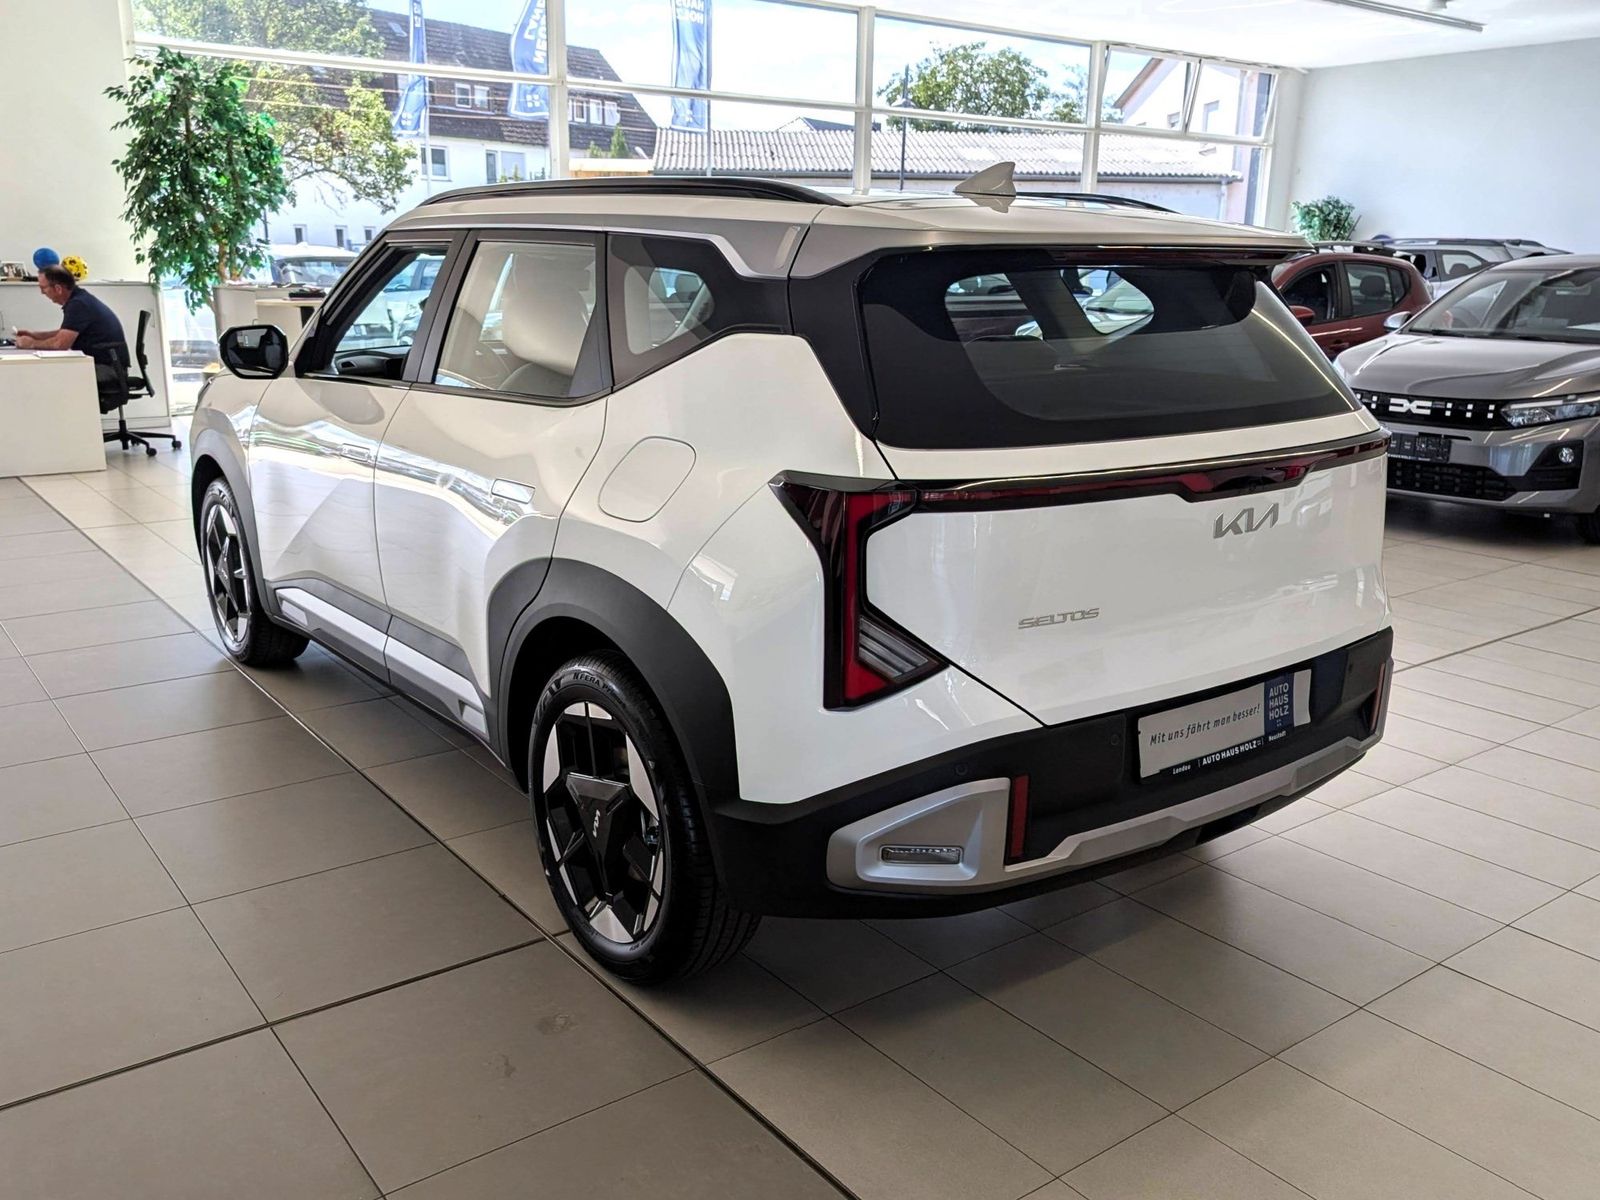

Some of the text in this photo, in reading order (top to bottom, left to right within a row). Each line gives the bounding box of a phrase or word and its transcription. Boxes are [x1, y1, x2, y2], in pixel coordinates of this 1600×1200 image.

[1214, 503, 1279, 539] KIA
[1018, 608, 1100, 629] SELTOS
[1269, 683, 1289, 697] AUTO
[1269, 695, 1289, 709] HAUS
[1269, 705, 1289, 720] HOLZ
[1150, 704, 1260, 746] Mit uns fährt man besser!
[1202, 753, 1221, 766] AUTO
[1221, 747, 1240, 759] HAUS
[1240, 740, 1257, 753] HOLZ
